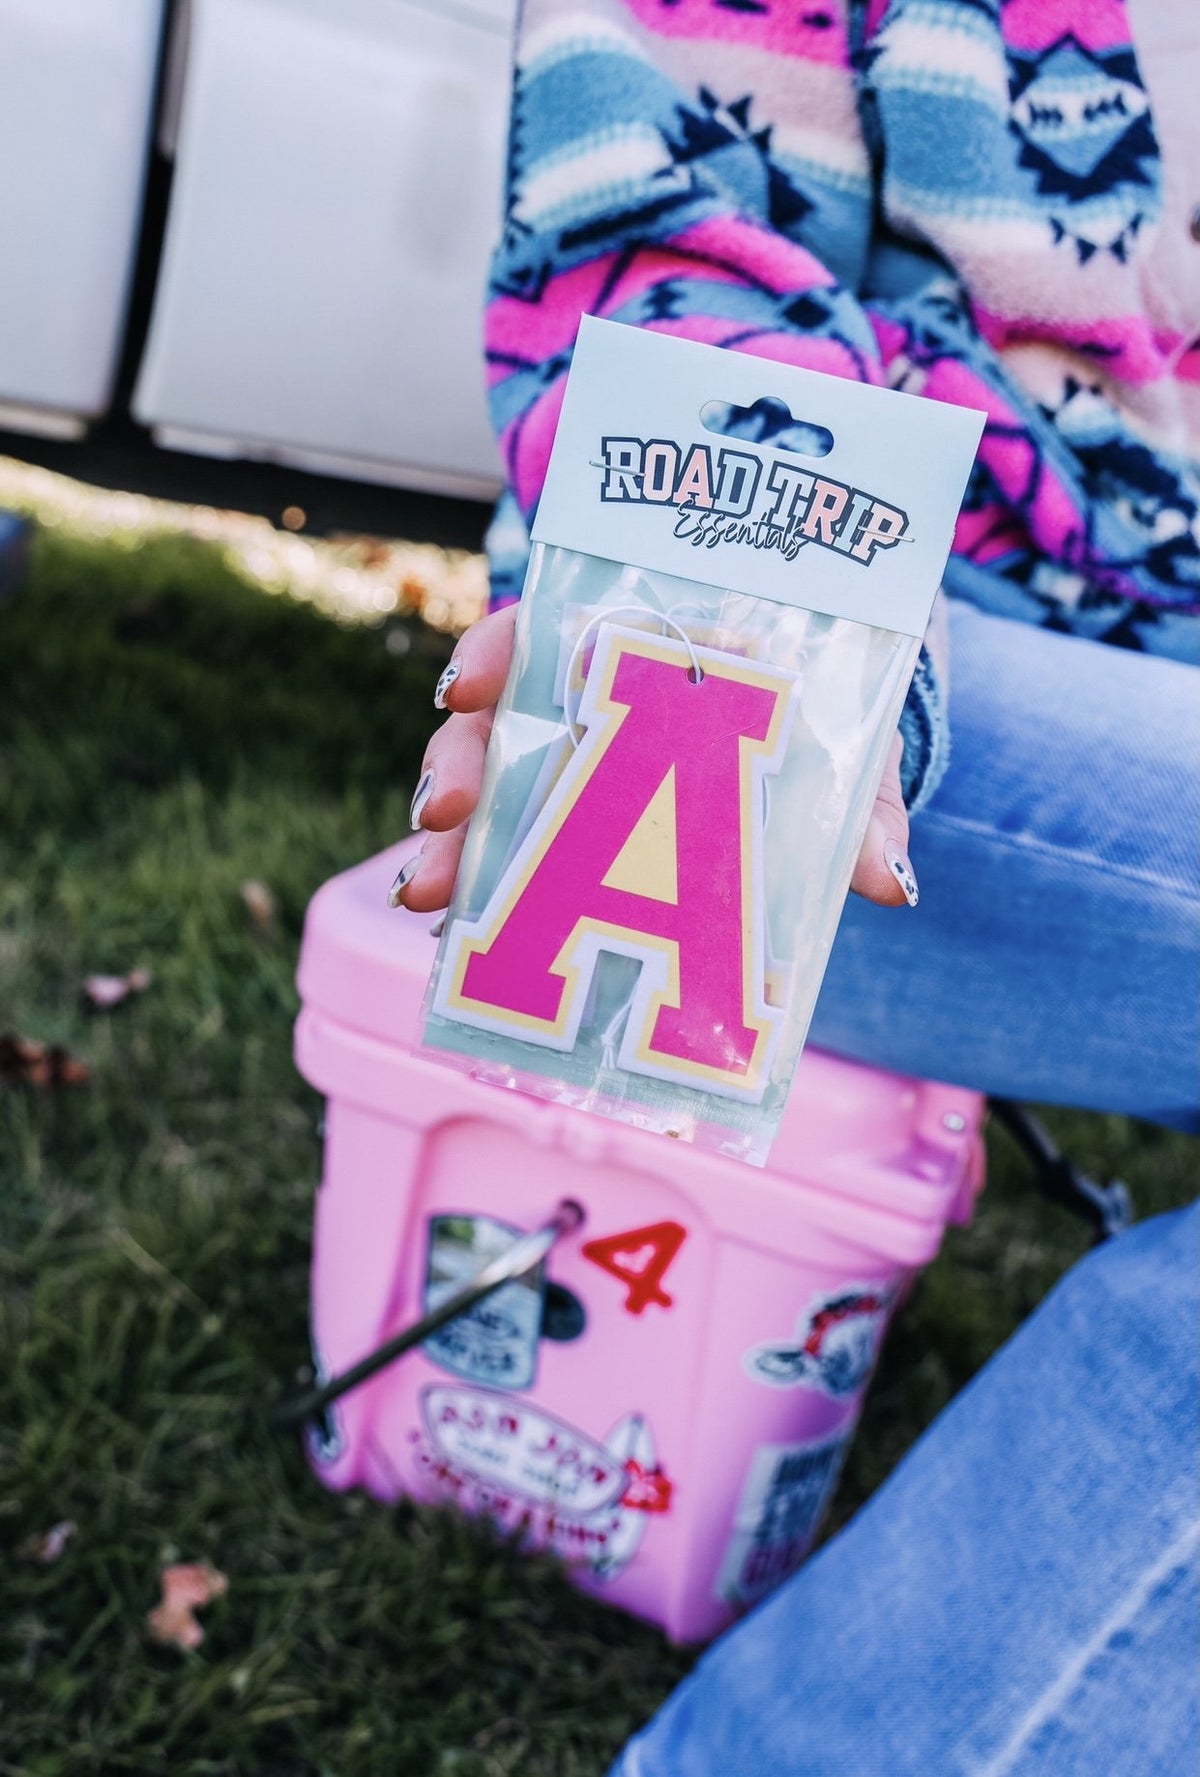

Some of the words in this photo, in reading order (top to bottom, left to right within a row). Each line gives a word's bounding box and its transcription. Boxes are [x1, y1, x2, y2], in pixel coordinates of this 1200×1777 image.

[601, 436, 763, 519] ROAD
[766, 460, 909, 566] TRIP
[673, 499, 809, 561] Essentials
[450, 638, 792, 1086] A
